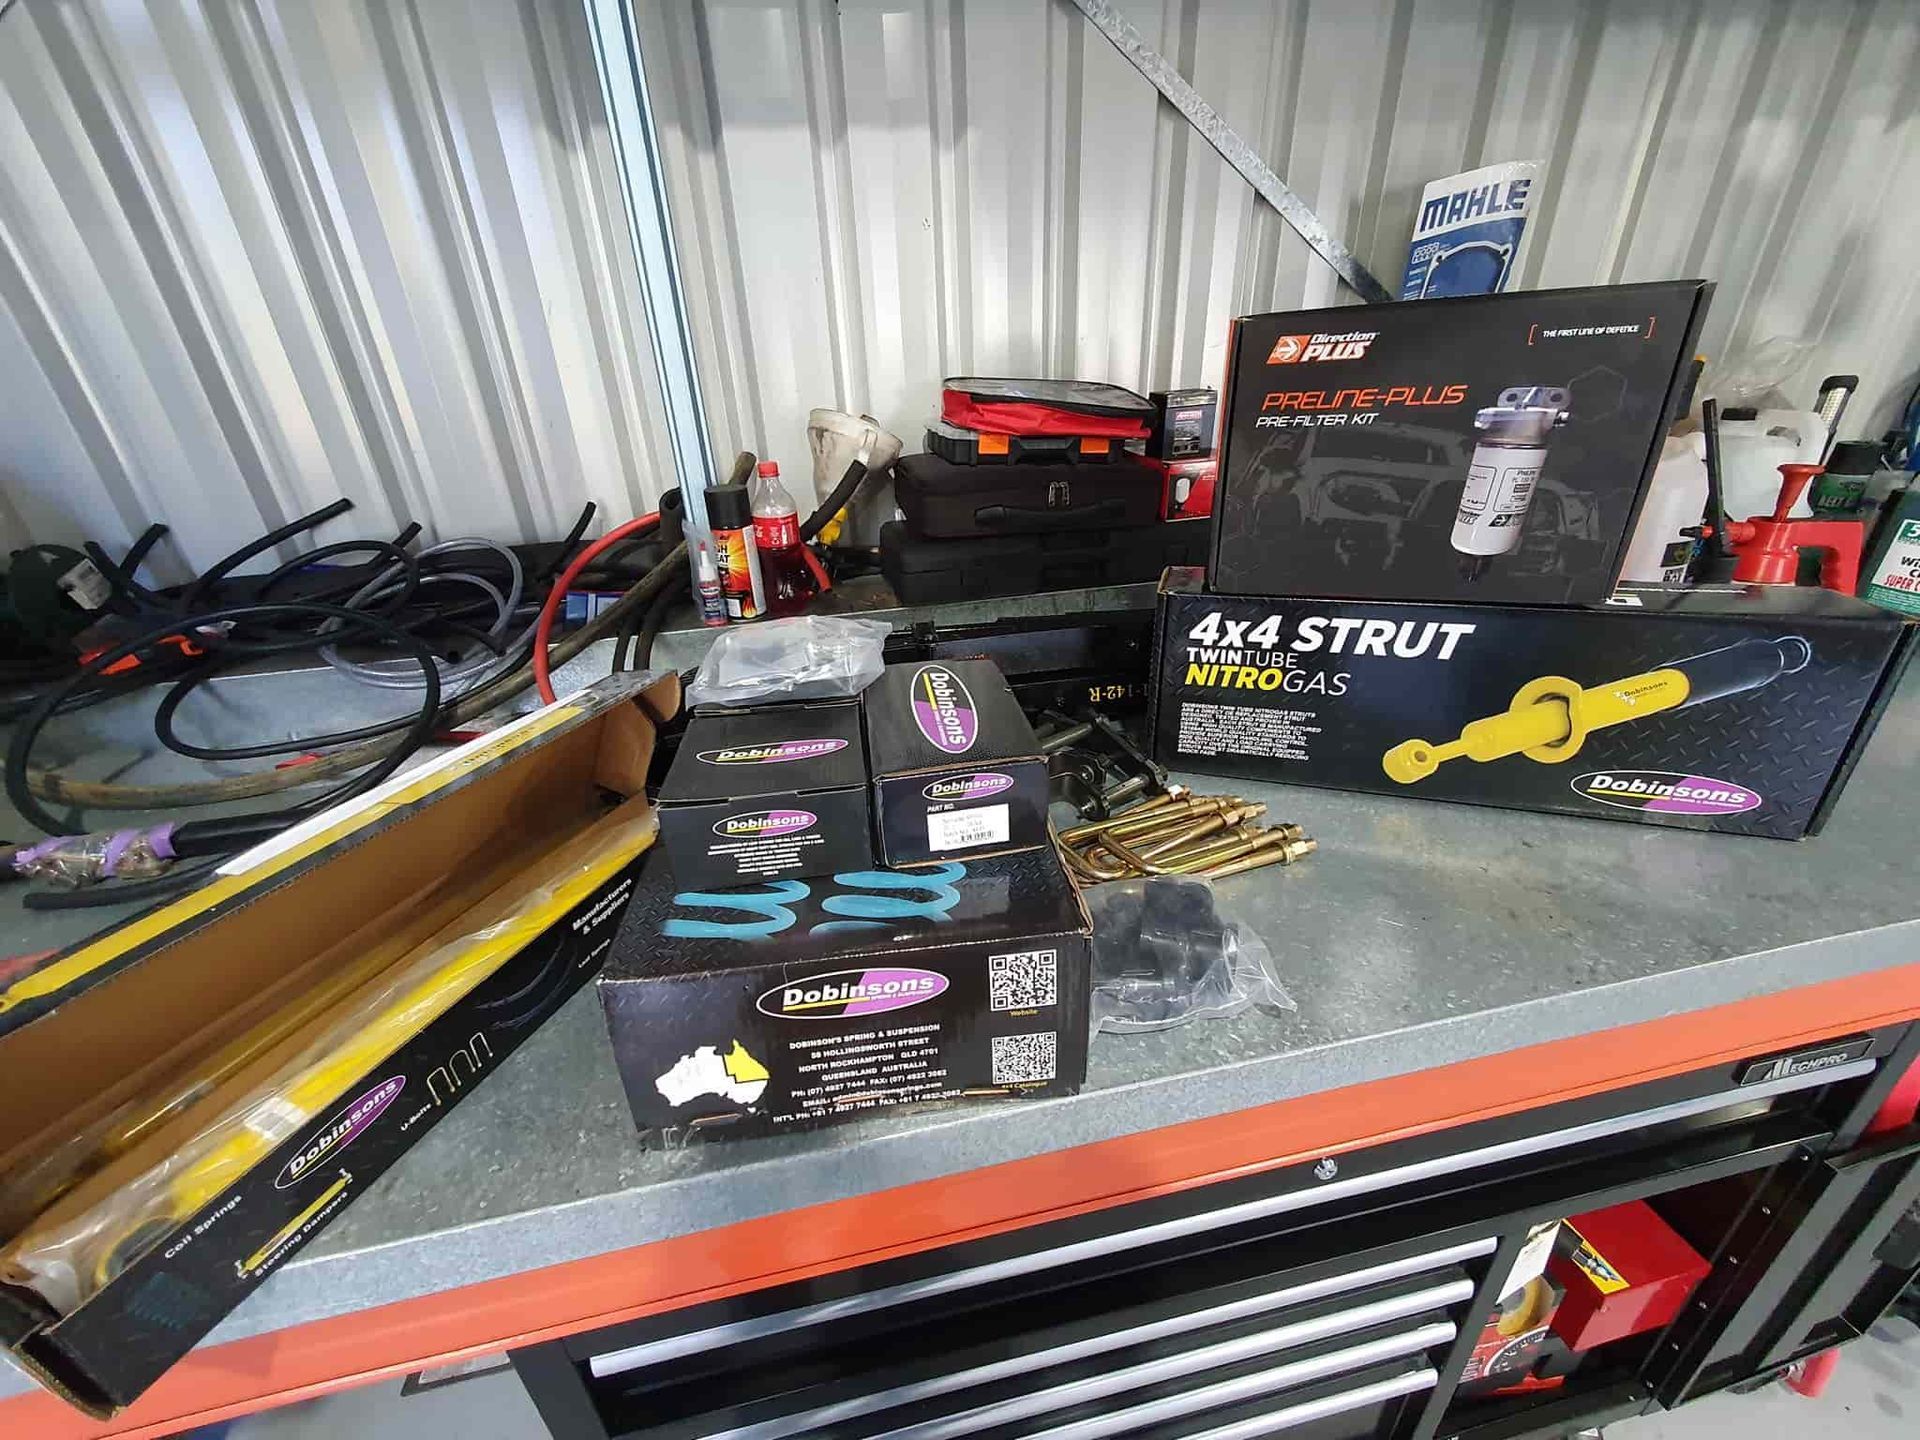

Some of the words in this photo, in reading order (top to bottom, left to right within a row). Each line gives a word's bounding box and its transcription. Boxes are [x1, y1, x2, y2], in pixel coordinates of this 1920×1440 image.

[1420, 179, 1531, 233] MAHLE
[1309, 331, 1376, 345] Direction
[1543, 330, 1557, 338] THE
[1558, 328, 1578, 337] FIRST
[1578, 328, 1594, 336] LINE
[1595, 327, 1606, 335] OF
[1606, 324, 1640, 334] DEFENCE
[1299, 341, 1371, 362] PLUS
[1261, 384, 1470, 411] PRELINE-PLUS
[1255, 413, 1347, 429] PRE-FILTER
[1351, 412, 1380, 425] KIT
[1884, 574, 1914, 590] SUPER
[1188, 612, 1283, 650] 4x4
[1291, 616, 1476, 661] STRUT
[1185, 662, 1351, 696] NITROGAS
[929, 672, 966, 745] Dobinsons
[718, 741, 838, 761] Dobinsons
[931, 776, 1008, 794] Dobinsons
[1590, 774, 1748, 804] Dobinsons
[726, 813, 810, 830] Dobinsons
[572, 878, 632, 931] Manufacturers
[592, 892, 630, 927] Suppliers
[782, 976, 935, 1007] Dobinsons
[844, 1032, 876, 1044] SPRING
[886, 1024, 940, 1038] SUSPENSION
[897, 1037, 930, 1048] STREET
[798, 1062, 829, 1073] NORTH
[830, 1054, 894, 1068] ROCKHAMPTON
[821, 1068, 878, 1082] QUEENSLAND
[881, 1060, 928, 1073] AUSTRALIA
[290, 1080, 397, 1176] Dobinsons
[164, 1235, 193, 1259] Coil
[194, 1194, 243, 1229] Springs
[254, 1232, 303, 1278] Steering
[302, 1190, 348, 1234] Dampers
